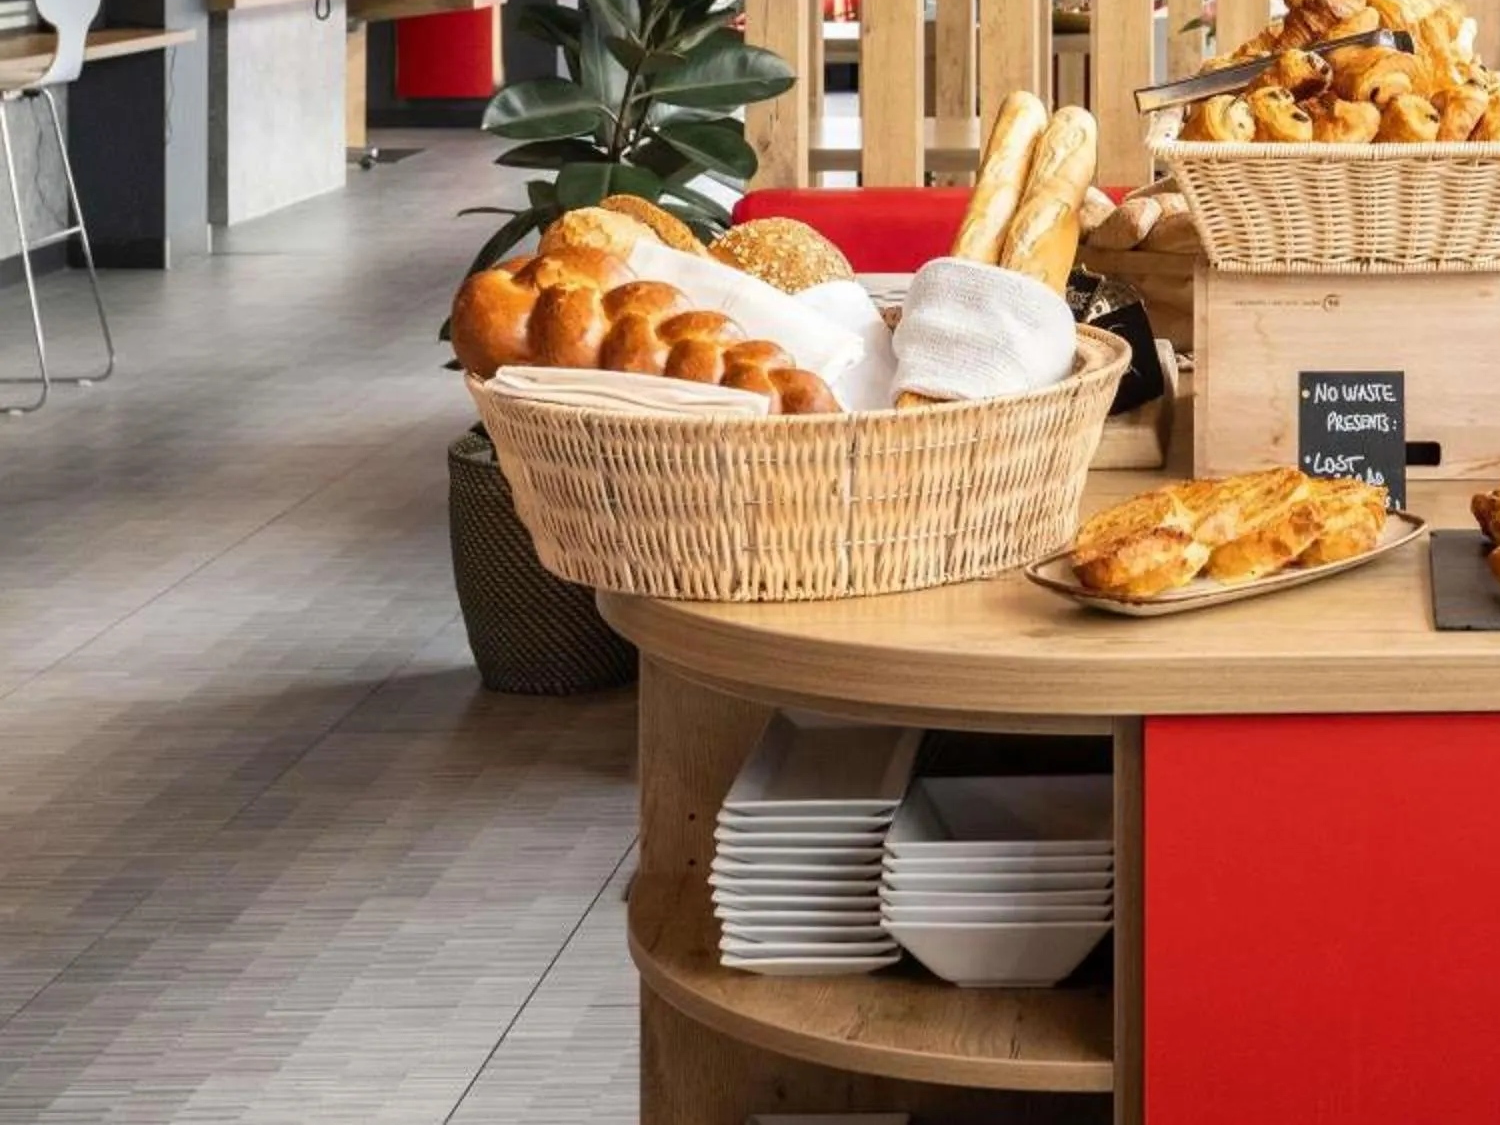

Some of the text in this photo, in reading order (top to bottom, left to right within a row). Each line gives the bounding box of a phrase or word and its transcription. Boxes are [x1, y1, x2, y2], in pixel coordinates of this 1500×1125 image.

[1313, 382, 1397, 404] NO WASTE
[1312, 452, 1366, 475] LOST
